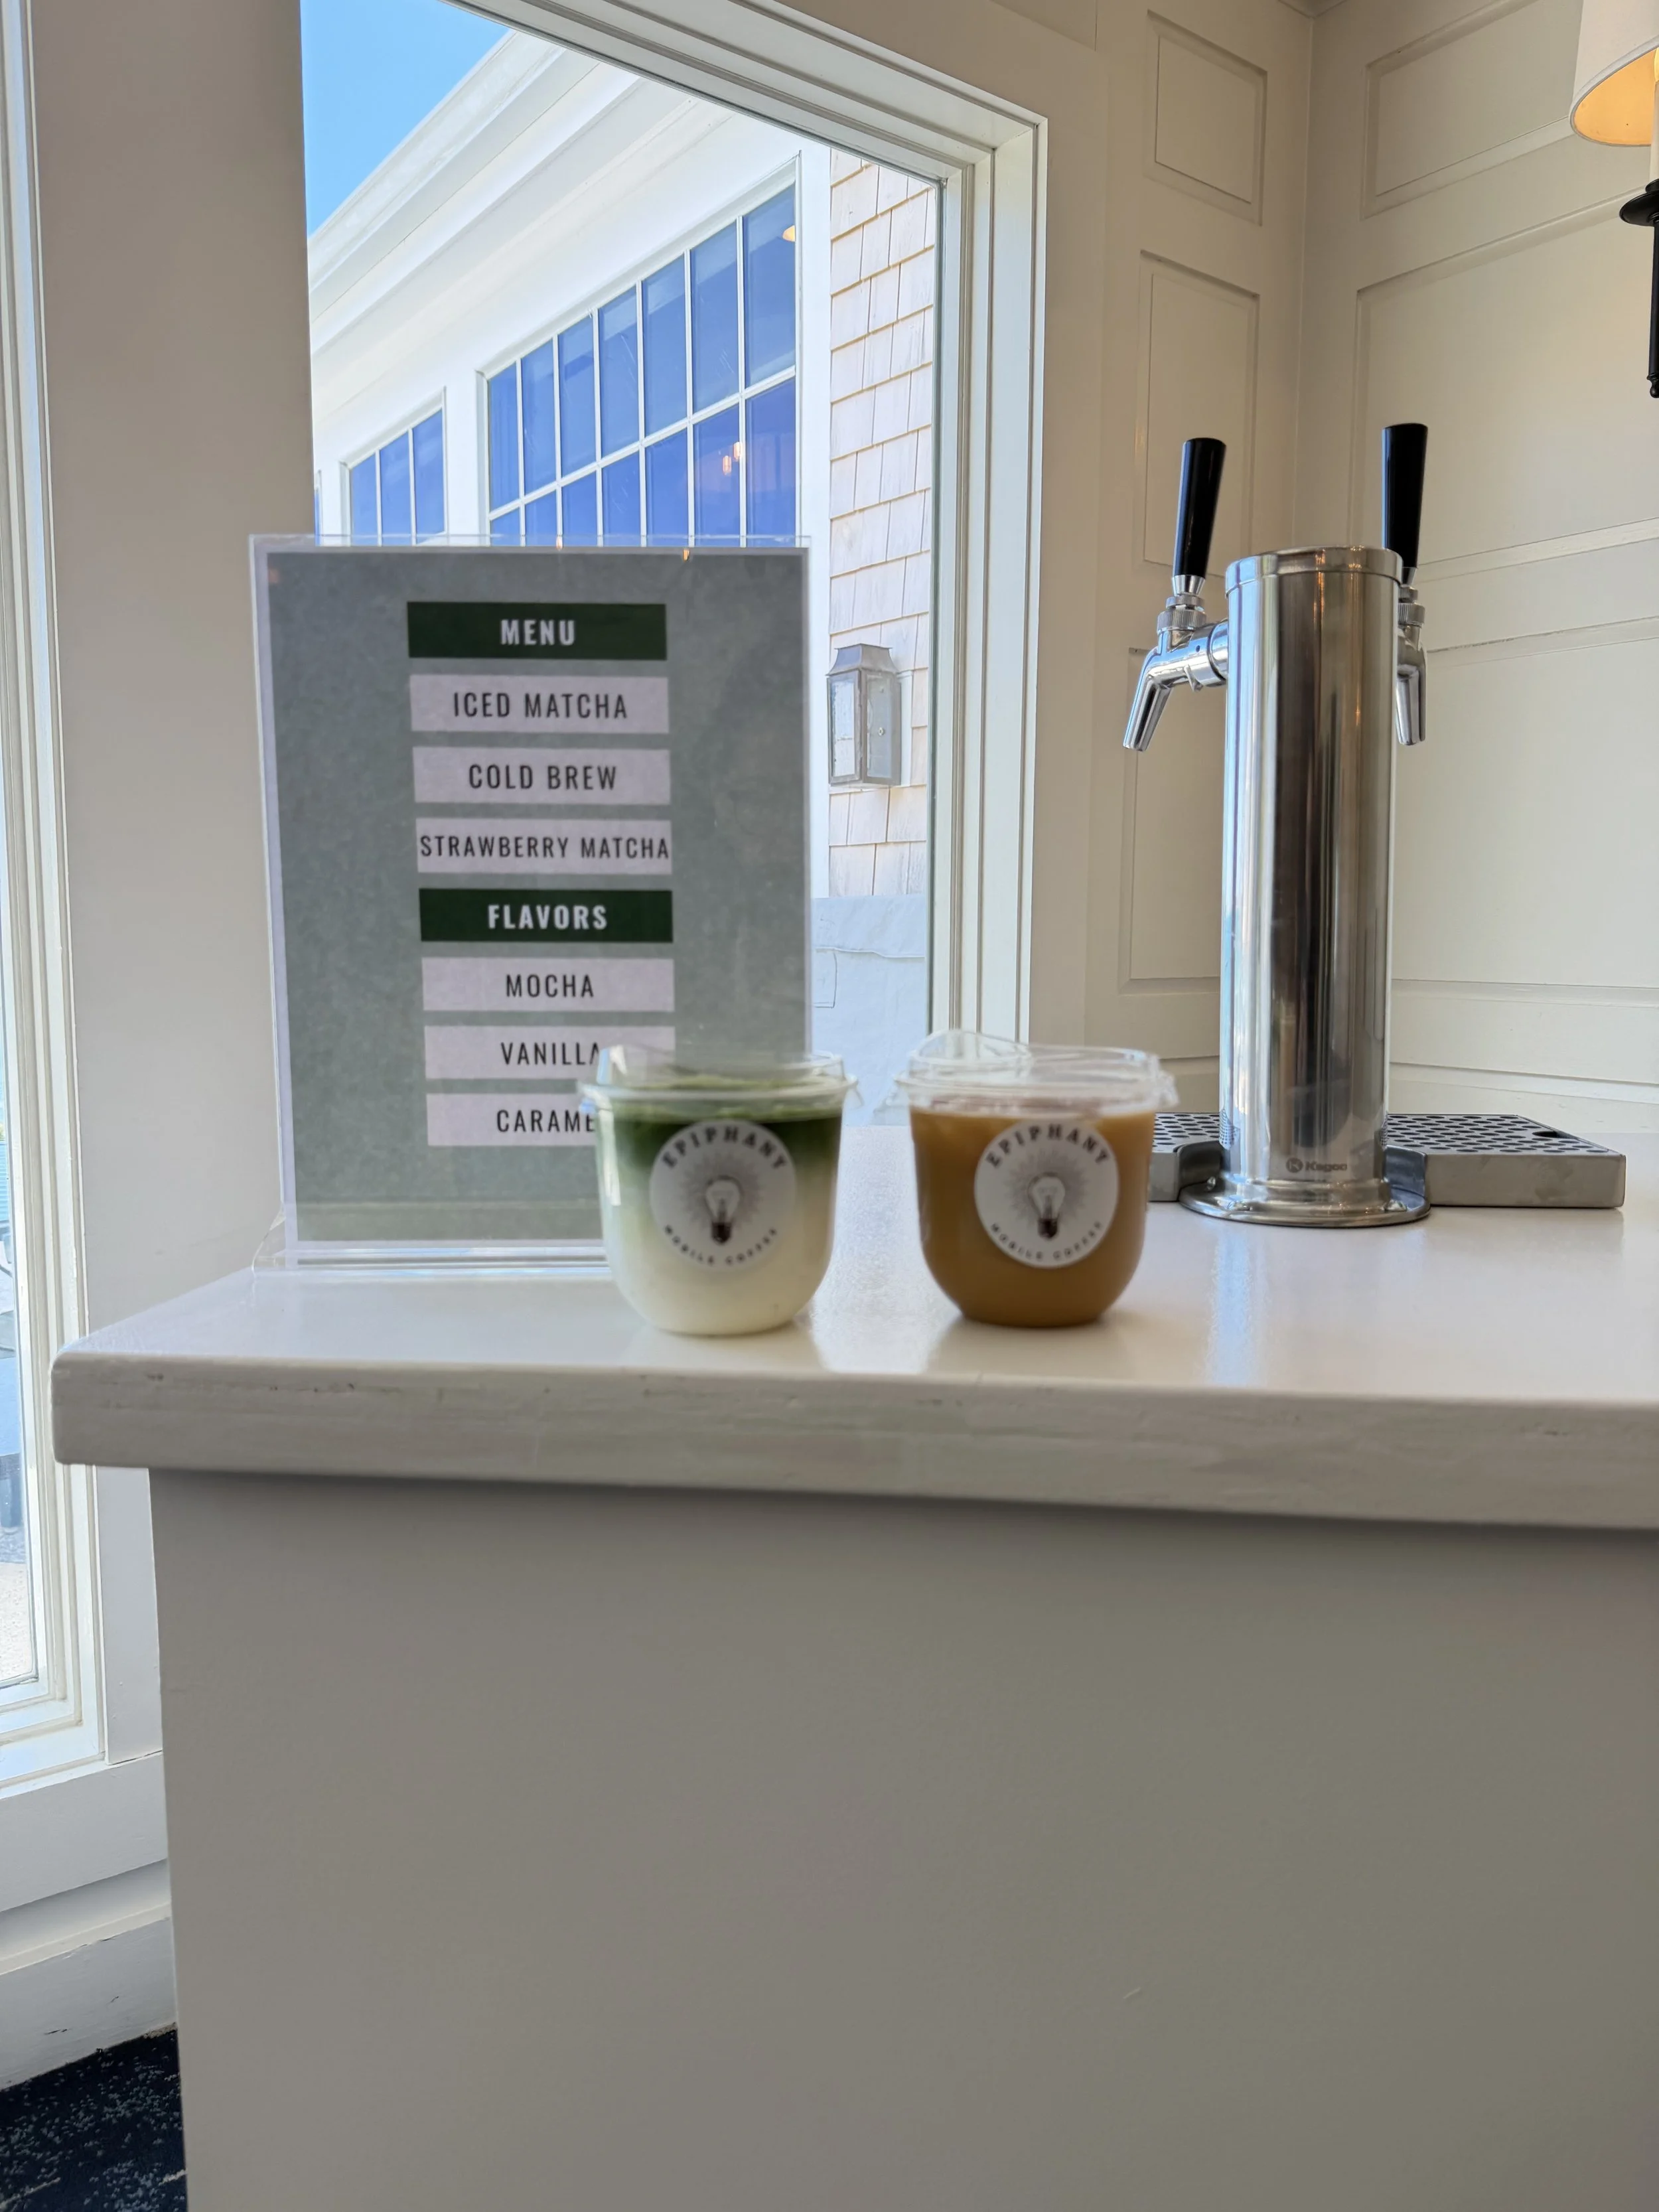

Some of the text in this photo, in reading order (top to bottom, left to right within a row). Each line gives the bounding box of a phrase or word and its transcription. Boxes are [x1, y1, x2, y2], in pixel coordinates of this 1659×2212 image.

[500, 619, 575, 646] MENU
[453, 692, 628, 719] ICED MATCHA
[469, 764, 616, 790] COLD BREW
[420, 835, 669, 859] STRAWBERRY MATCHA
[488, 905, 608, 930] FLAVORS
[506, 974, 594, 997] MOCHA
[500, 1042, 600, 1065] VANILLA
[496, 1110, 595, 1132] CARAME
[663, 1126, 787, 1170] EPIPHANY
[985, 1124, 1109, 1168] EPIPHANY
